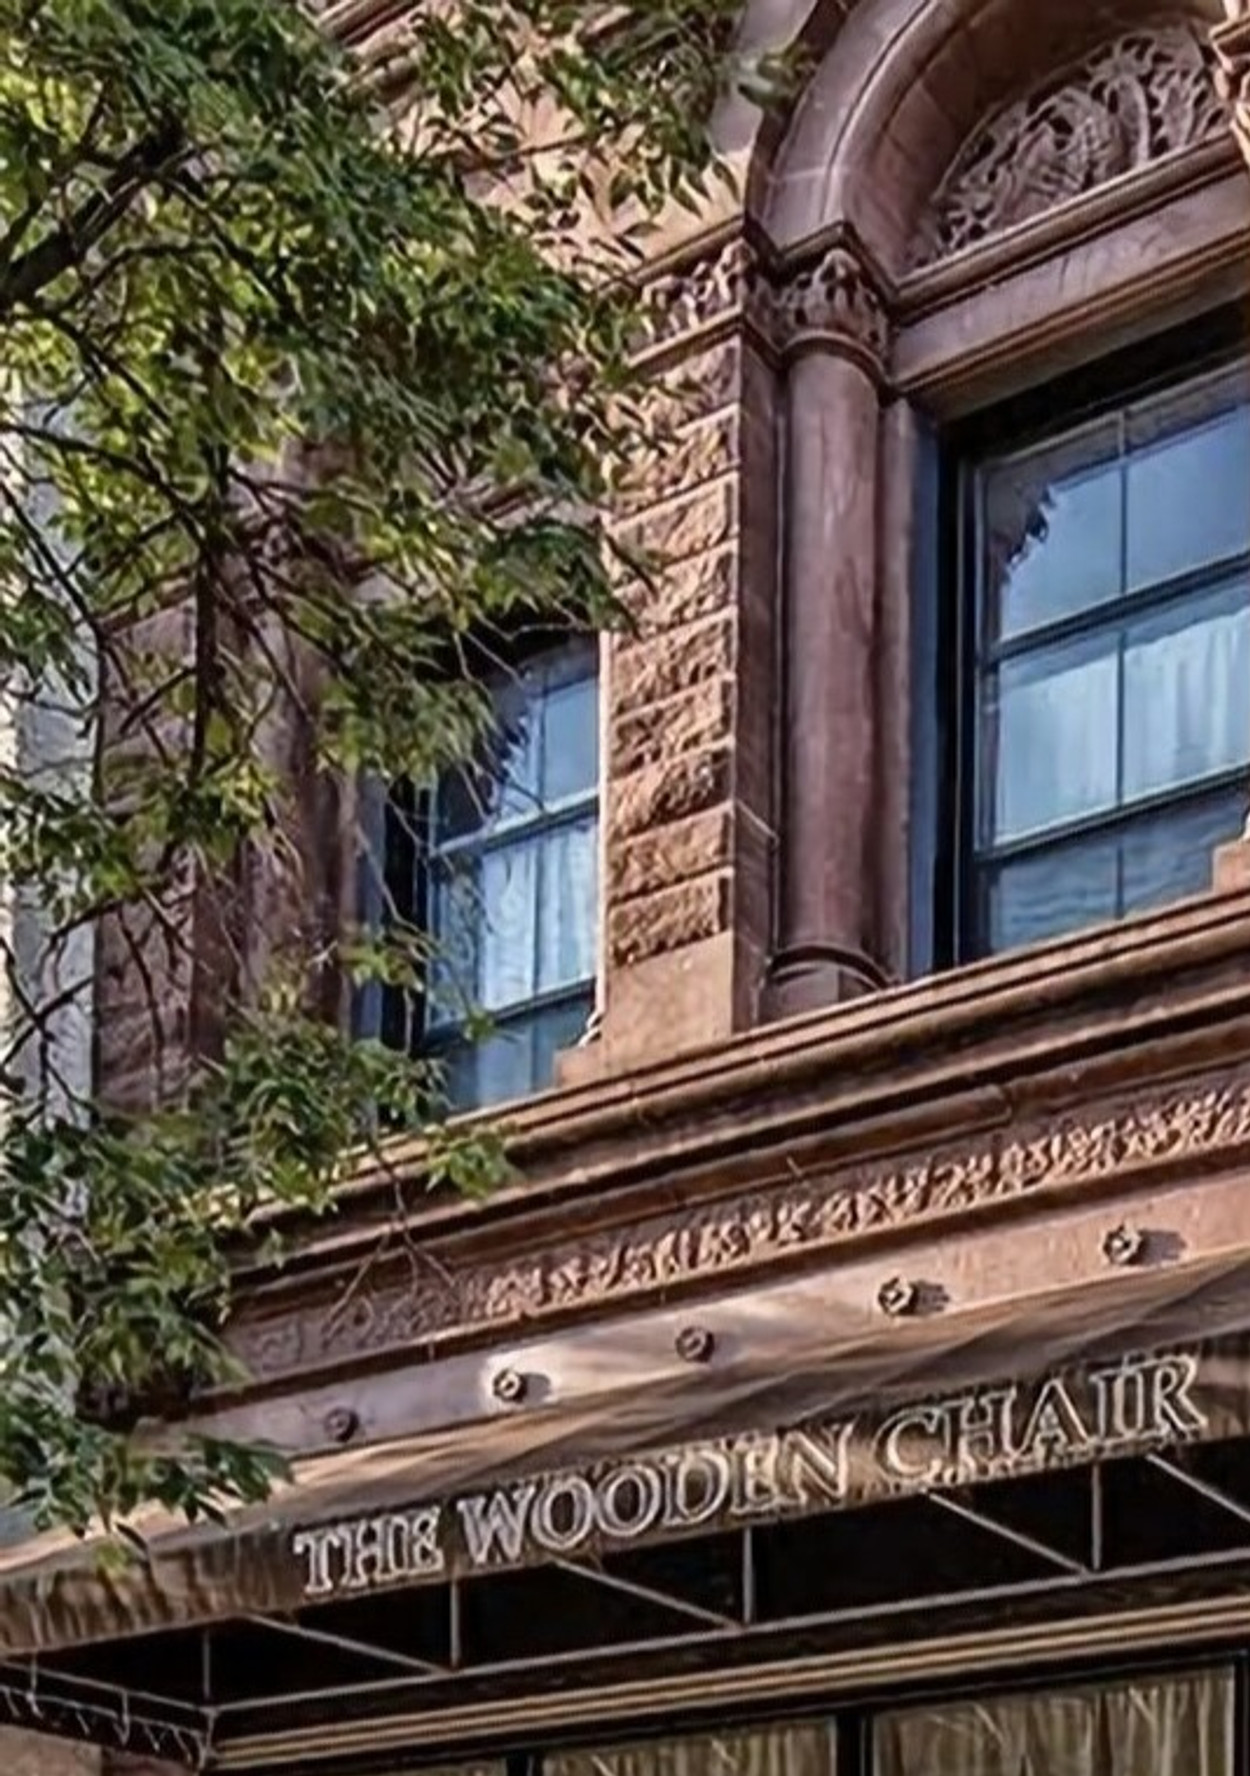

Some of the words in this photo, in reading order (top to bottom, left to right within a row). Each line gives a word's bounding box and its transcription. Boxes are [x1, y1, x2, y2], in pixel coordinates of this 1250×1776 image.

[293, 1506, 445, 1594] THE
[457, 1422, 854, 1565] WOODEN
[873, 1354, 1208, 1486] CHAIR
